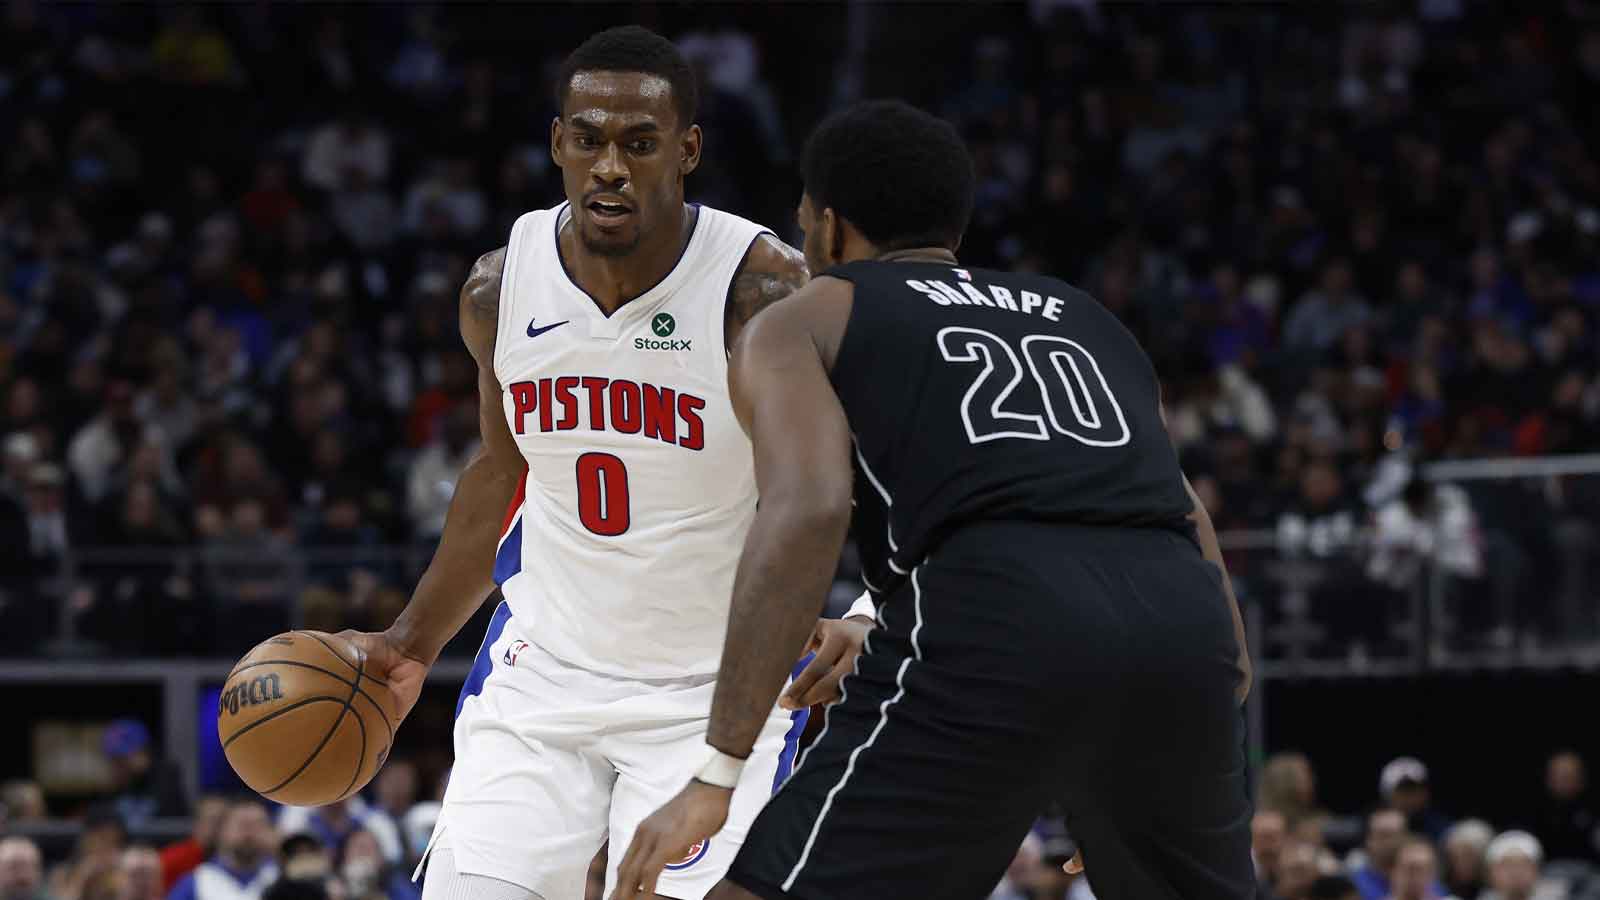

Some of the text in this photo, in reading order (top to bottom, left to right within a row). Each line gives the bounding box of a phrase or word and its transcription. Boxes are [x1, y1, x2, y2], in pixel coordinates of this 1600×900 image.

[905, 279, 1065, 322] SHARPE
[634, 338, 692, 352] StockX
[509, 376, 706, 451] PISTONS
[936, 326, 1131, 447] 20
[576, 452, 630, 537] 0
